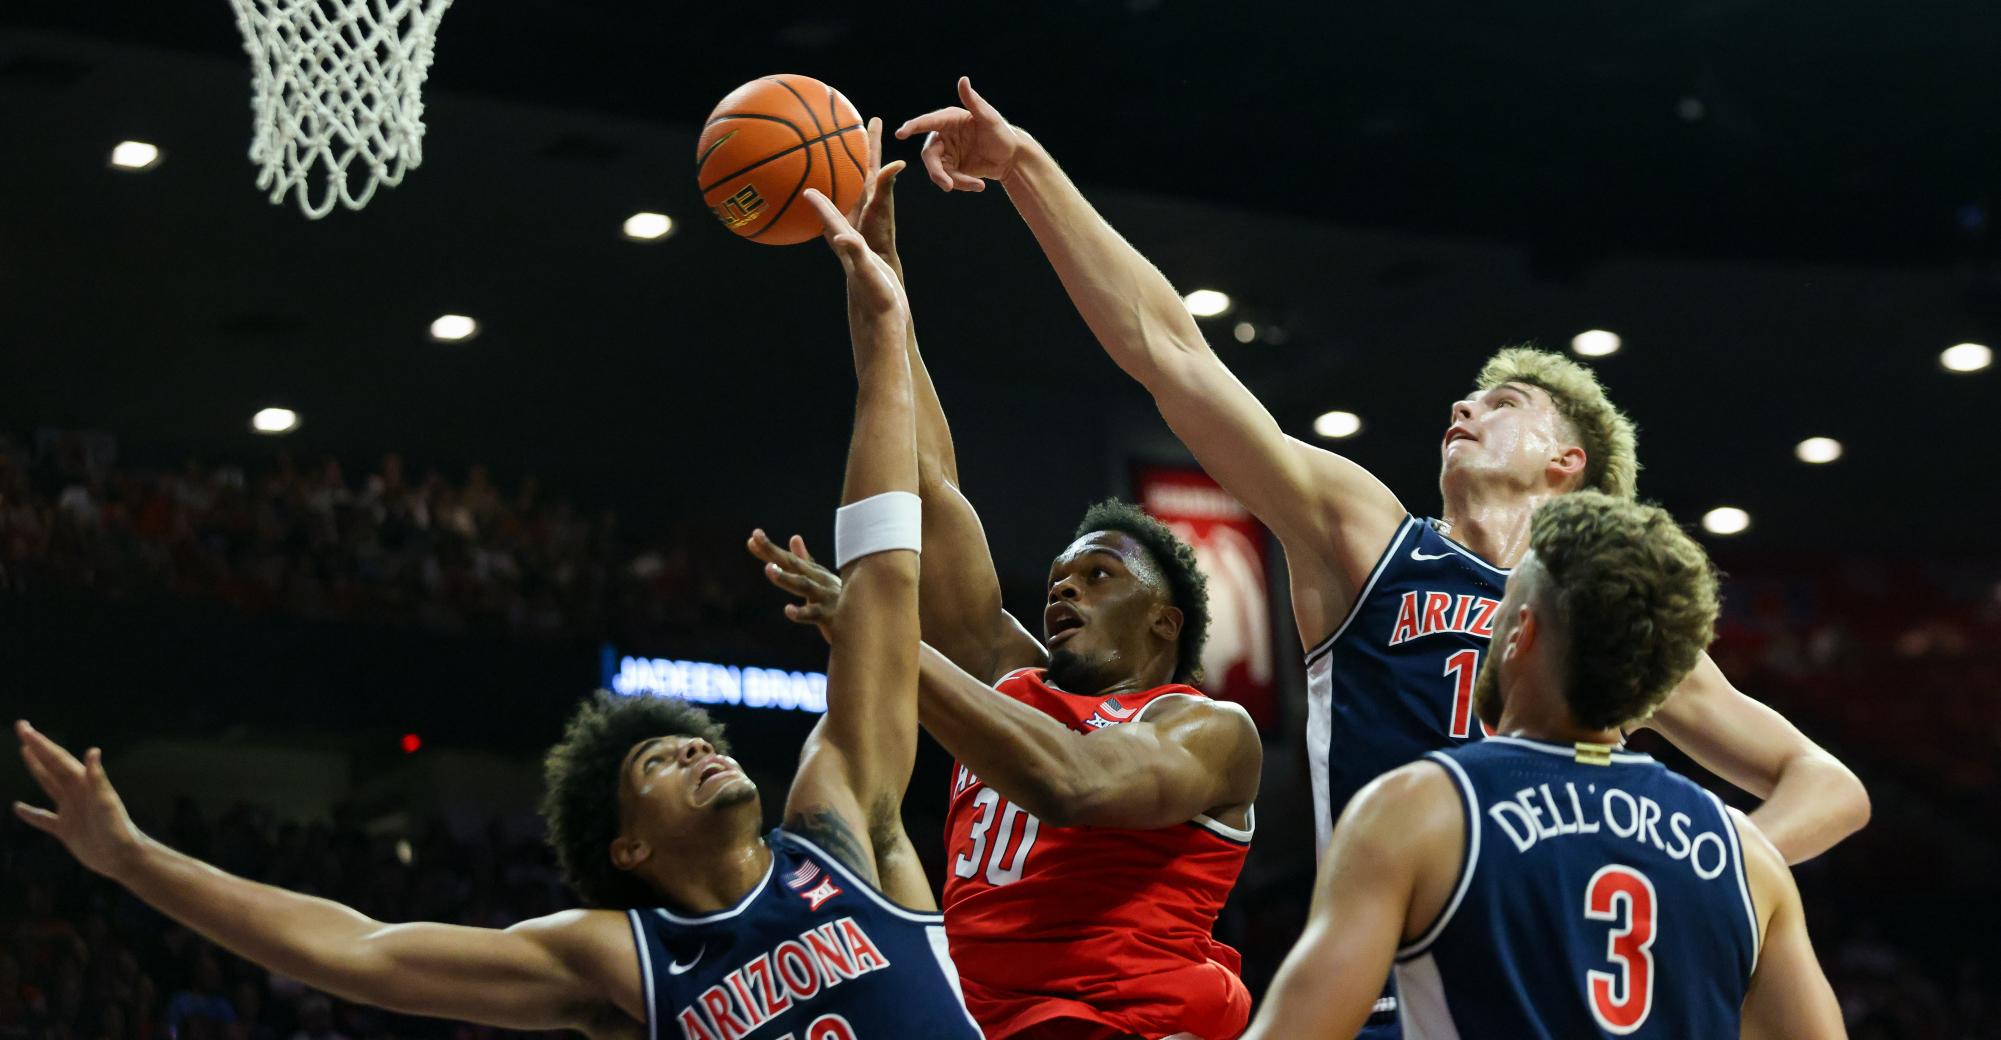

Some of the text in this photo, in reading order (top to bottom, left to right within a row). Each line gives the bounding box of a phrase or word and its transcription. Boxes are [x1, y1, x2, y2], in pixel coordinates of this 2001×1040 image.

[955, 787, 1040, 887] 30
[1489, 782, 1727, 880] DELL'ORSO
[676, 916, 890, 1040] ARIZONA
[1584, 863, 1658, 1036] 3
